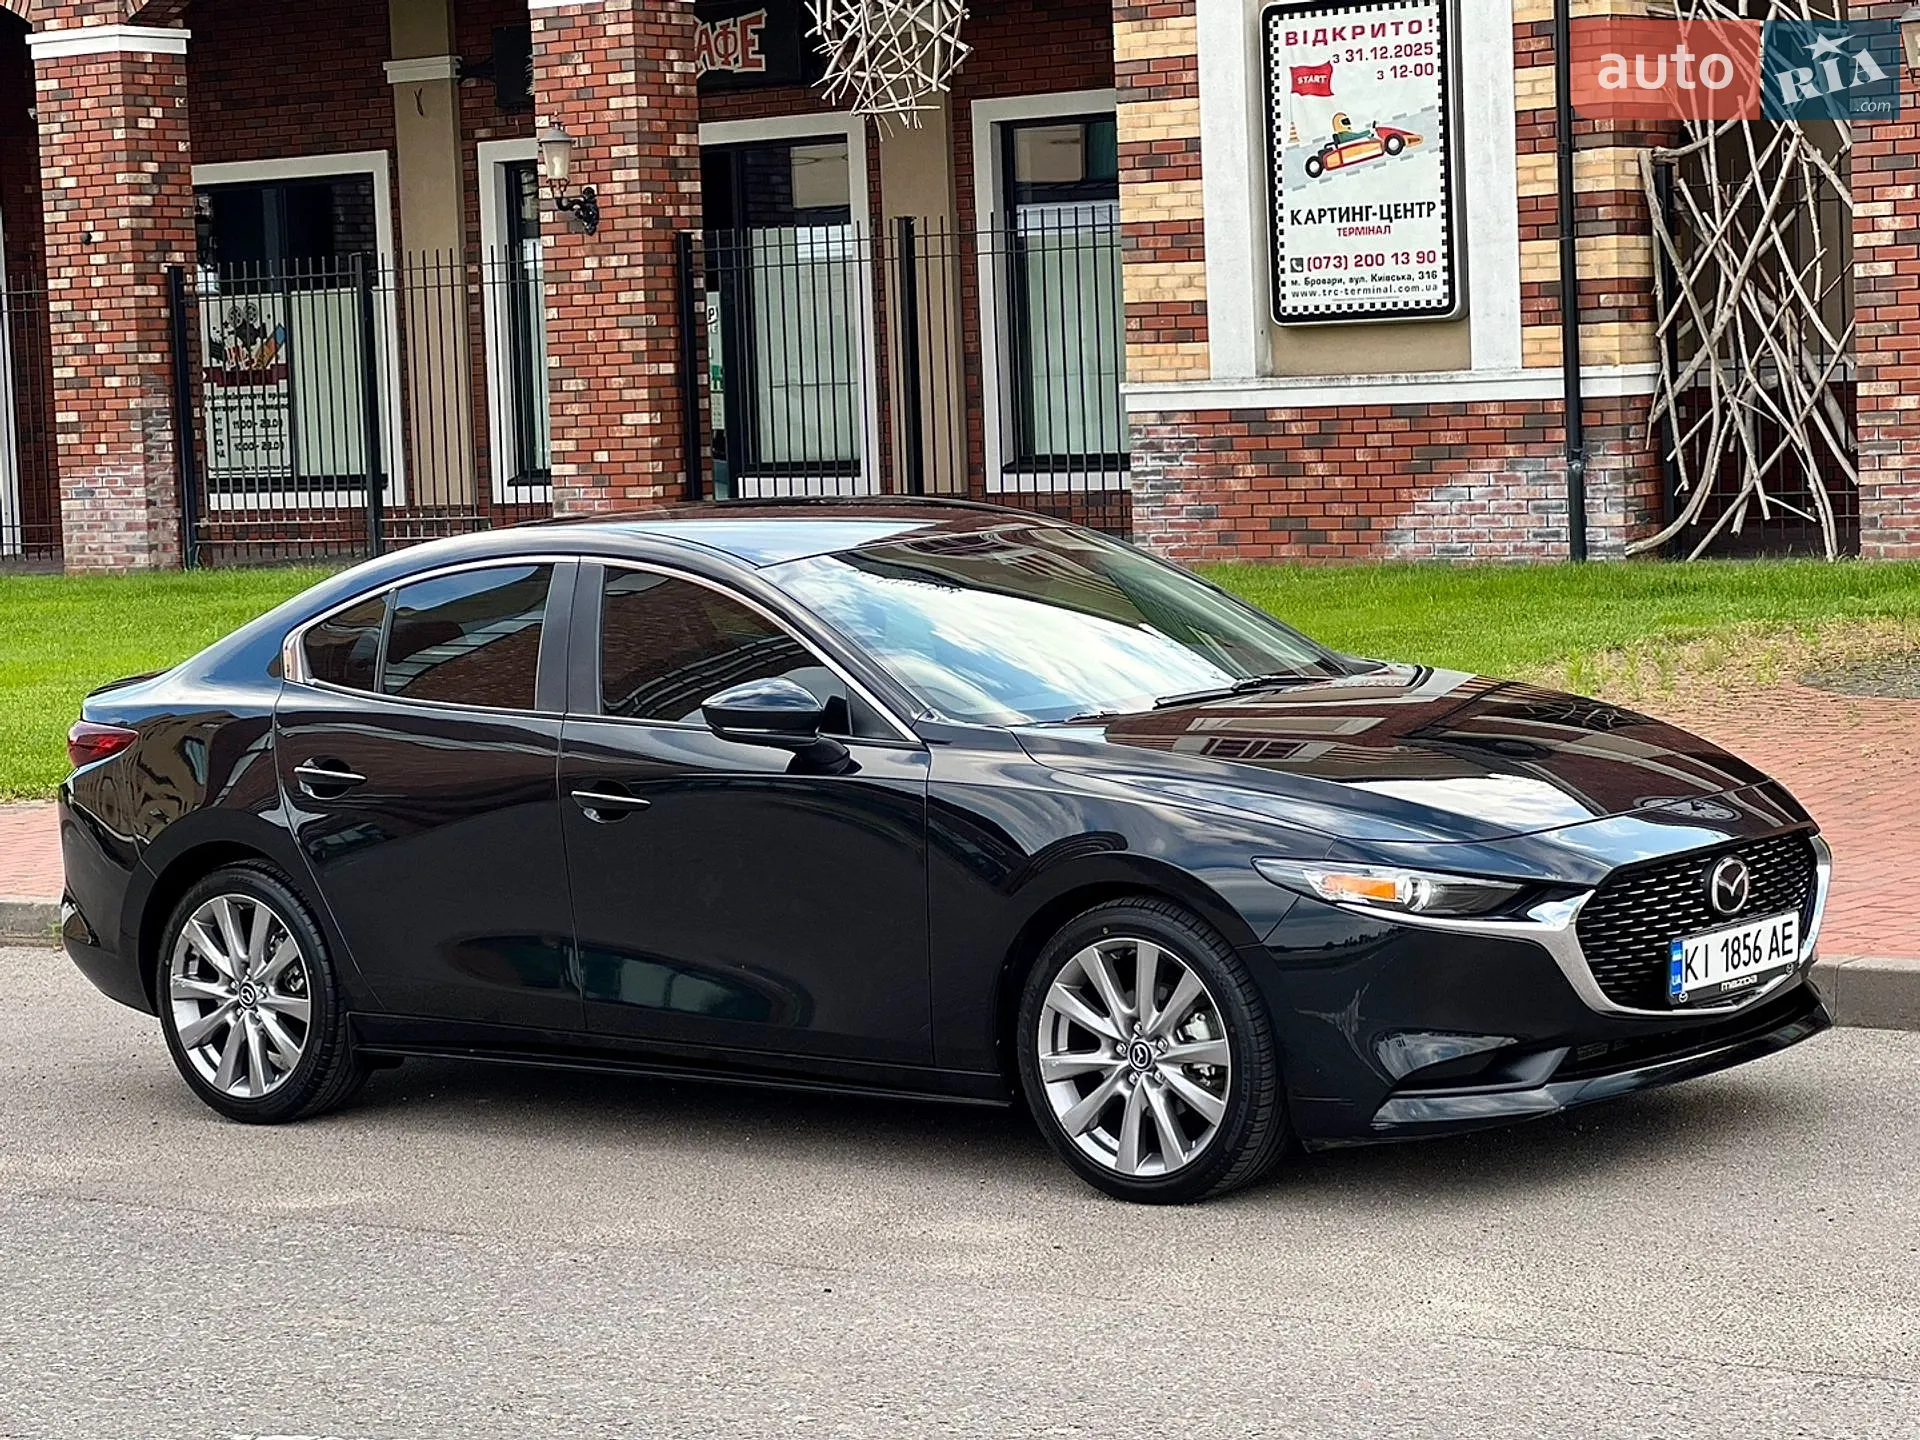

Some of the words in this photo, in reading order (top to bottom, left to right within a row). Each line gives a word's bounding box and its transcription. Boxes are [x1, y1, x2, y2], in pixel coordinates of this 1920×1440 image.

[1285, 18, 1434, 47] ВІДКРИТО!
[693, 8, 767, 79] АФЕ
[1345, 42, 1434, 63] 31.12.2025
[1297, 74, 1327, 85] START
[1390, 62, 1435, 79] 12-00
[1290, 201, 1437, 226] КАРТИНГ-ЦЕНТР
[1336, 225, 1391, 238] ТЕРМІНАЛ
[1307, 255, 1349, 272] (073)
[1353, 253, 1386, 268] 200
[1391, 252, 1411, 266] 13
[1416, 250, 1437, 264] 90
[1304, 276, 1346, 287] Бровари,
[1418, 270, 1438, 280] 316
[1291, 283, 1438, 298] www.trc-terminal.com.ua
[1684, 944, 1709, 983] KI
[1720, 929, 1762, 972] 1856
[1768, 920, 1794, 961] AE
